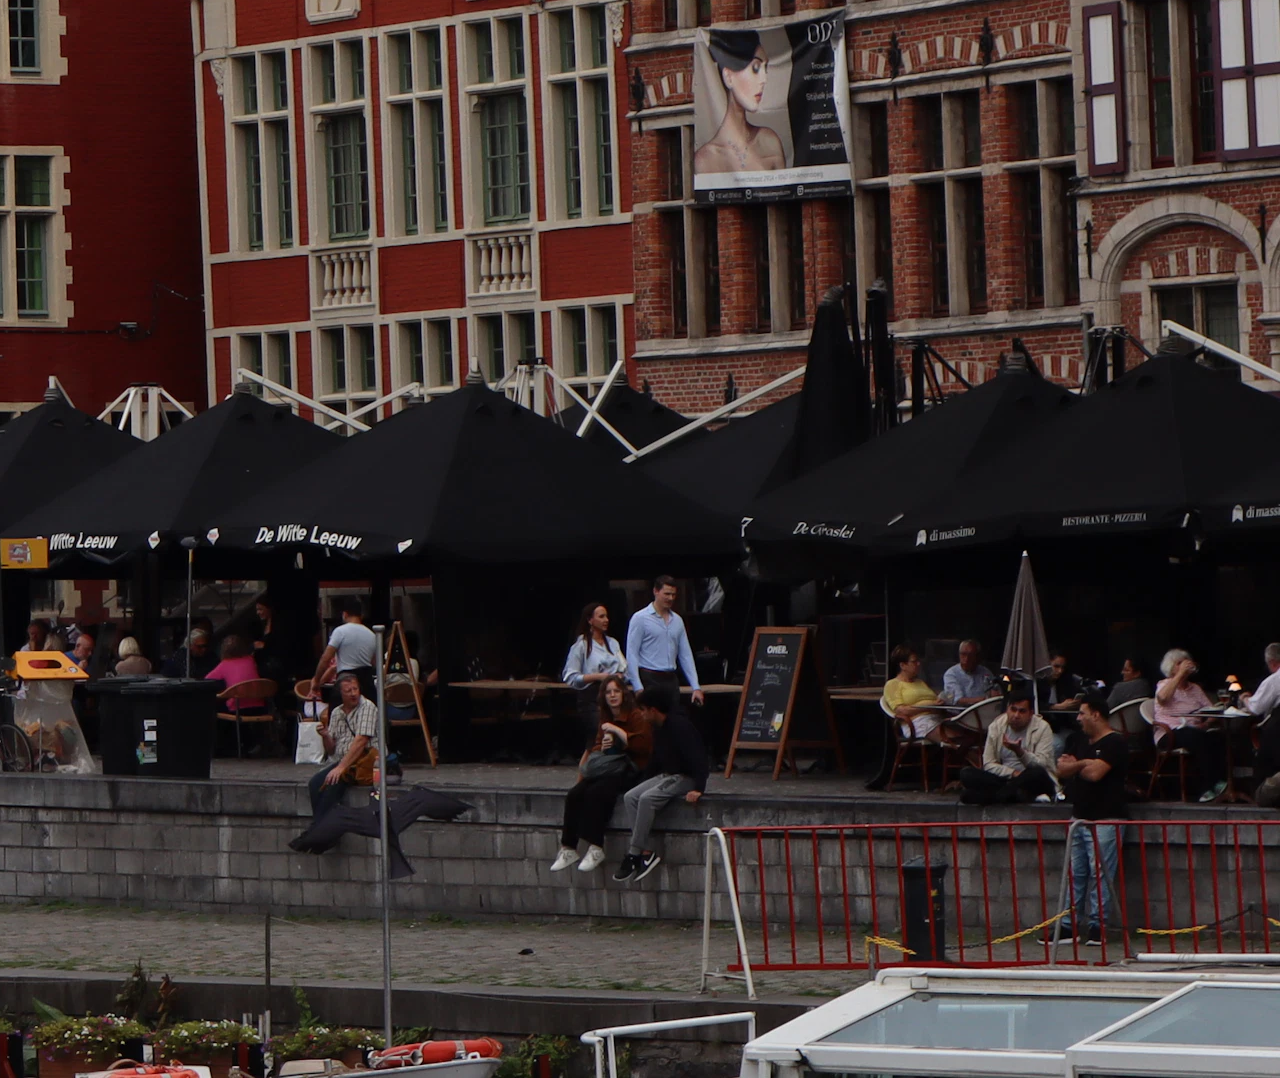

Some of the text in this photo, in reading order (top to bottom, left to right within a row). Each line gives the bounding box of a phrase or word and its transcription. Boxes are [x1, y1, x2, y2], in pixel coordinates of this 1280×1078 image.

[1062, 512, 1147, 526] RISTORANTE PIZZERIA
[1245, 506, 1255, 518] di
[254, 523, 363, 550] De Witte Leeuw
[792, 522, 856, 539] De Graslei
[929, 526, 976, 542] di massimo
[49, 531, 119, 551] Witte Leeuw
